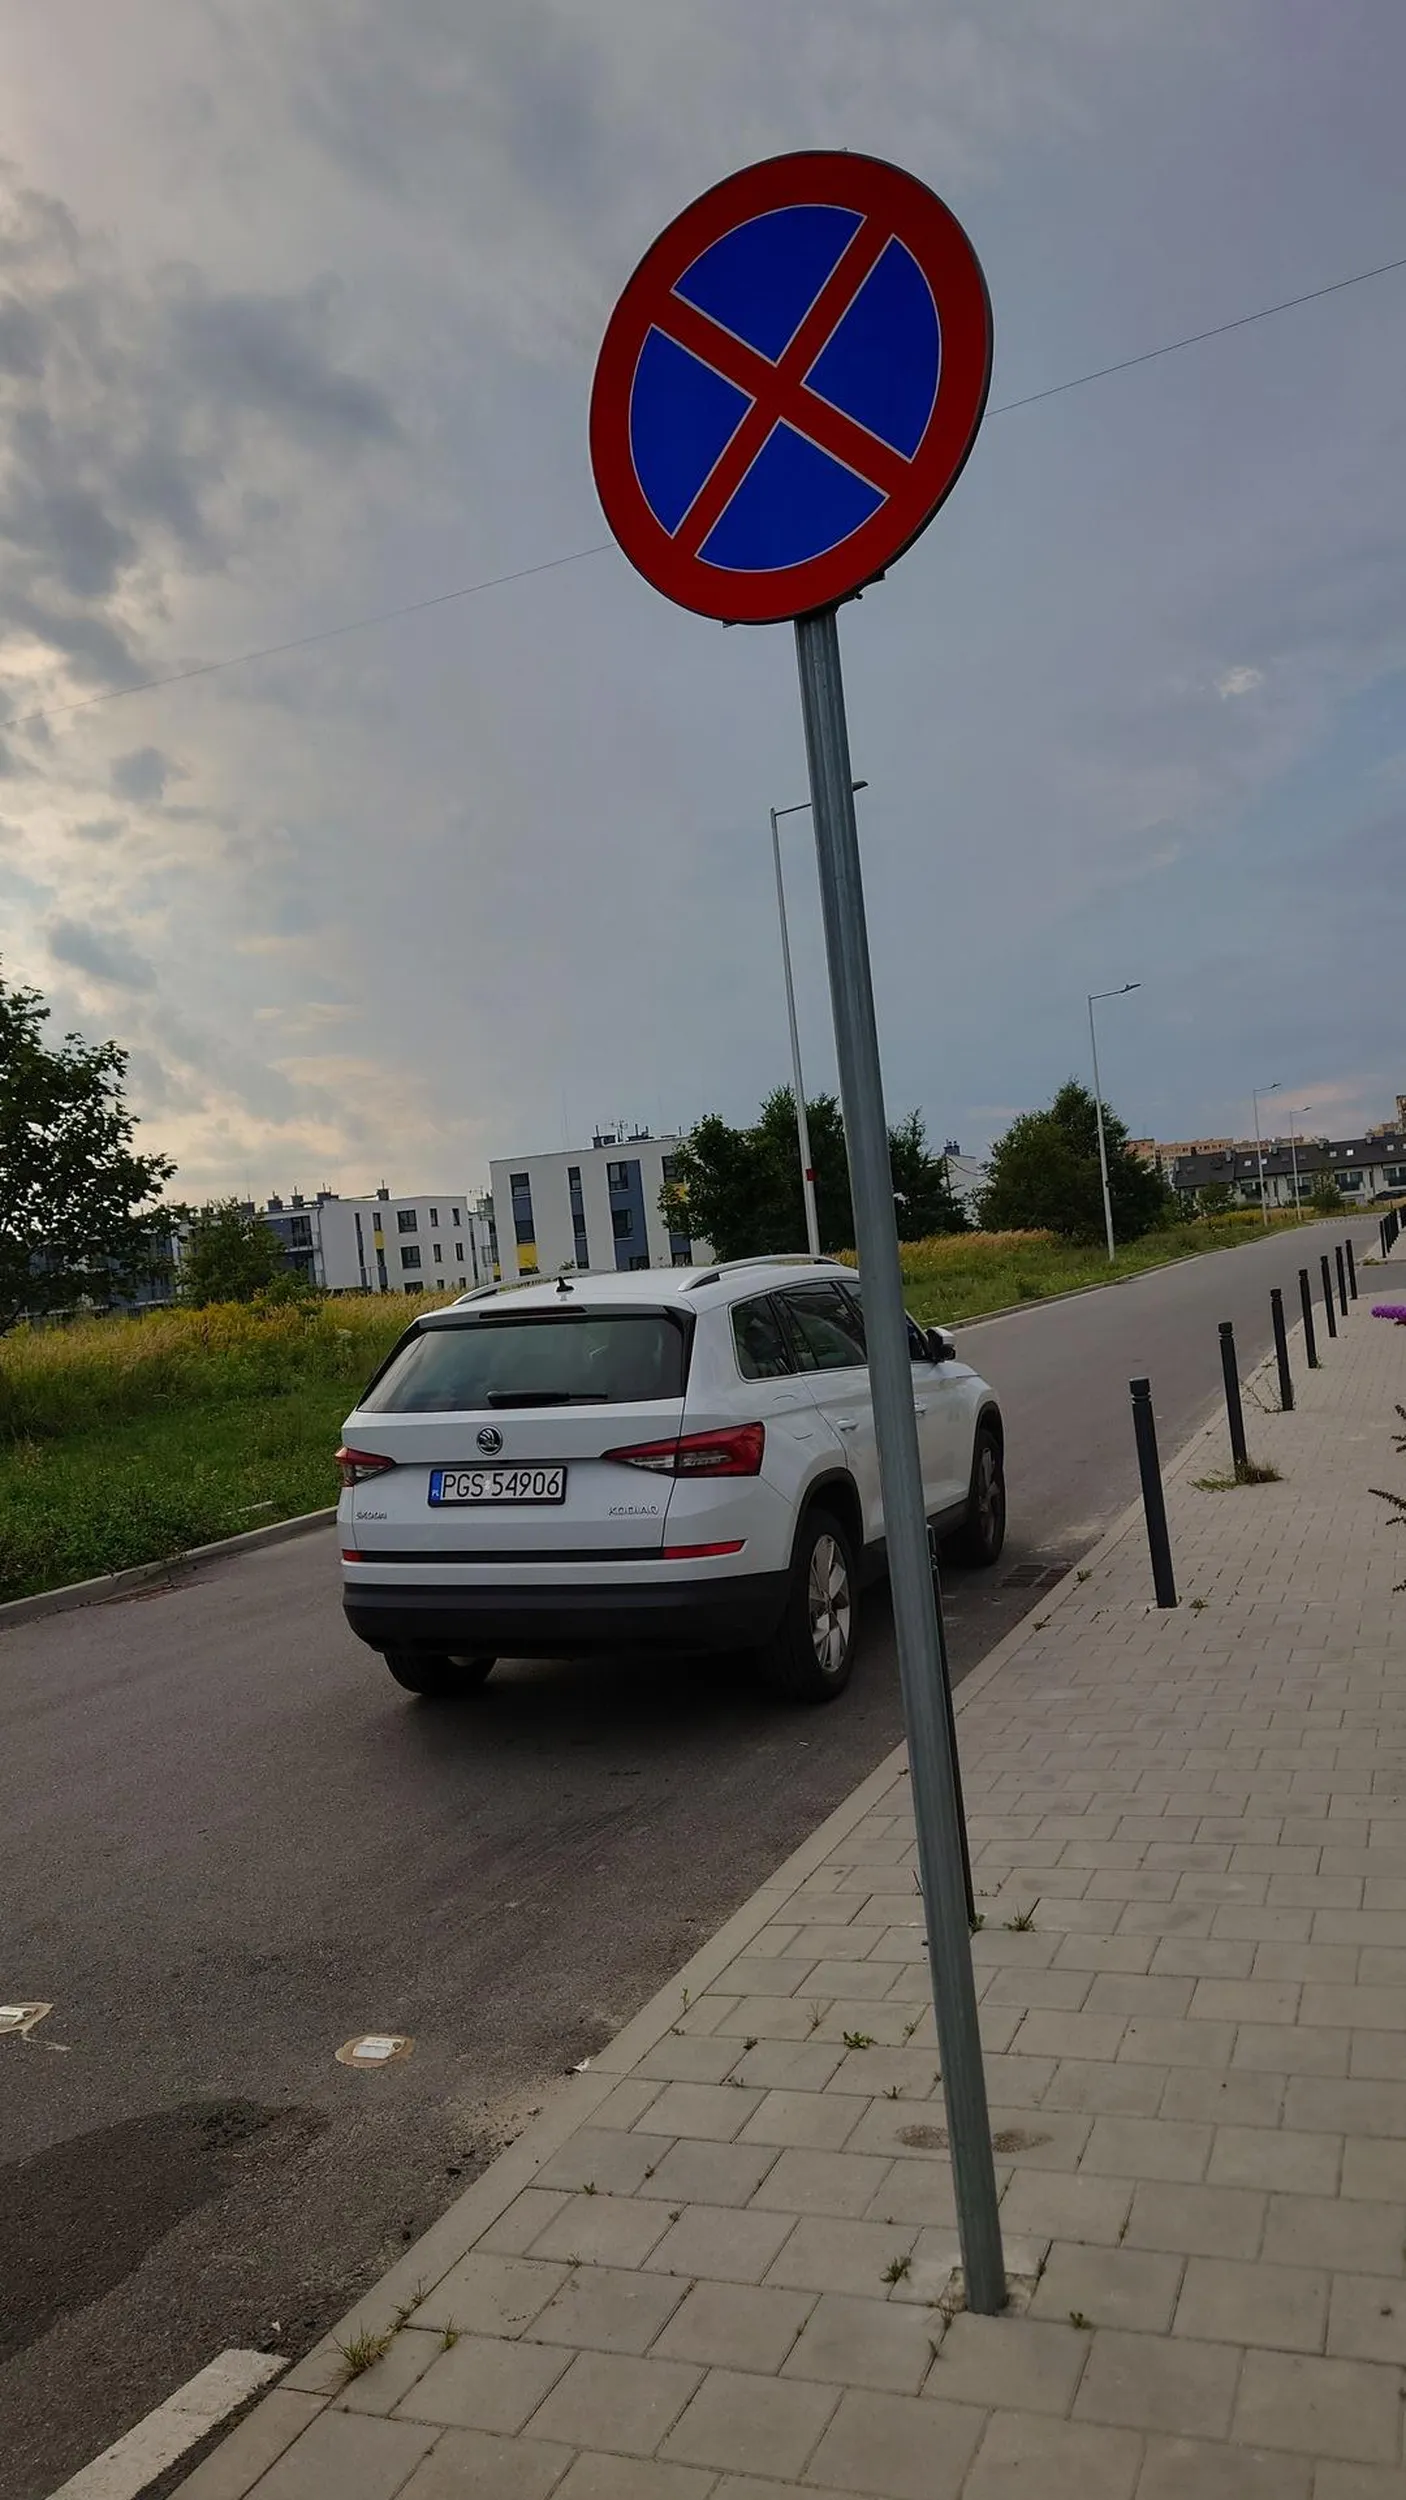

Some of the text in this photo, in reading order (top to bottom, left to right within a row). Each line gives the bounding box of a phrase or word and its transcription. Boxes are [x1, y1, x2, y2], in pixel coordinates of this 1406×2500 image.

[442, 1471, 561, 1498] PGS 54906
[608, 1505, 659, 1517] KODIAQ
